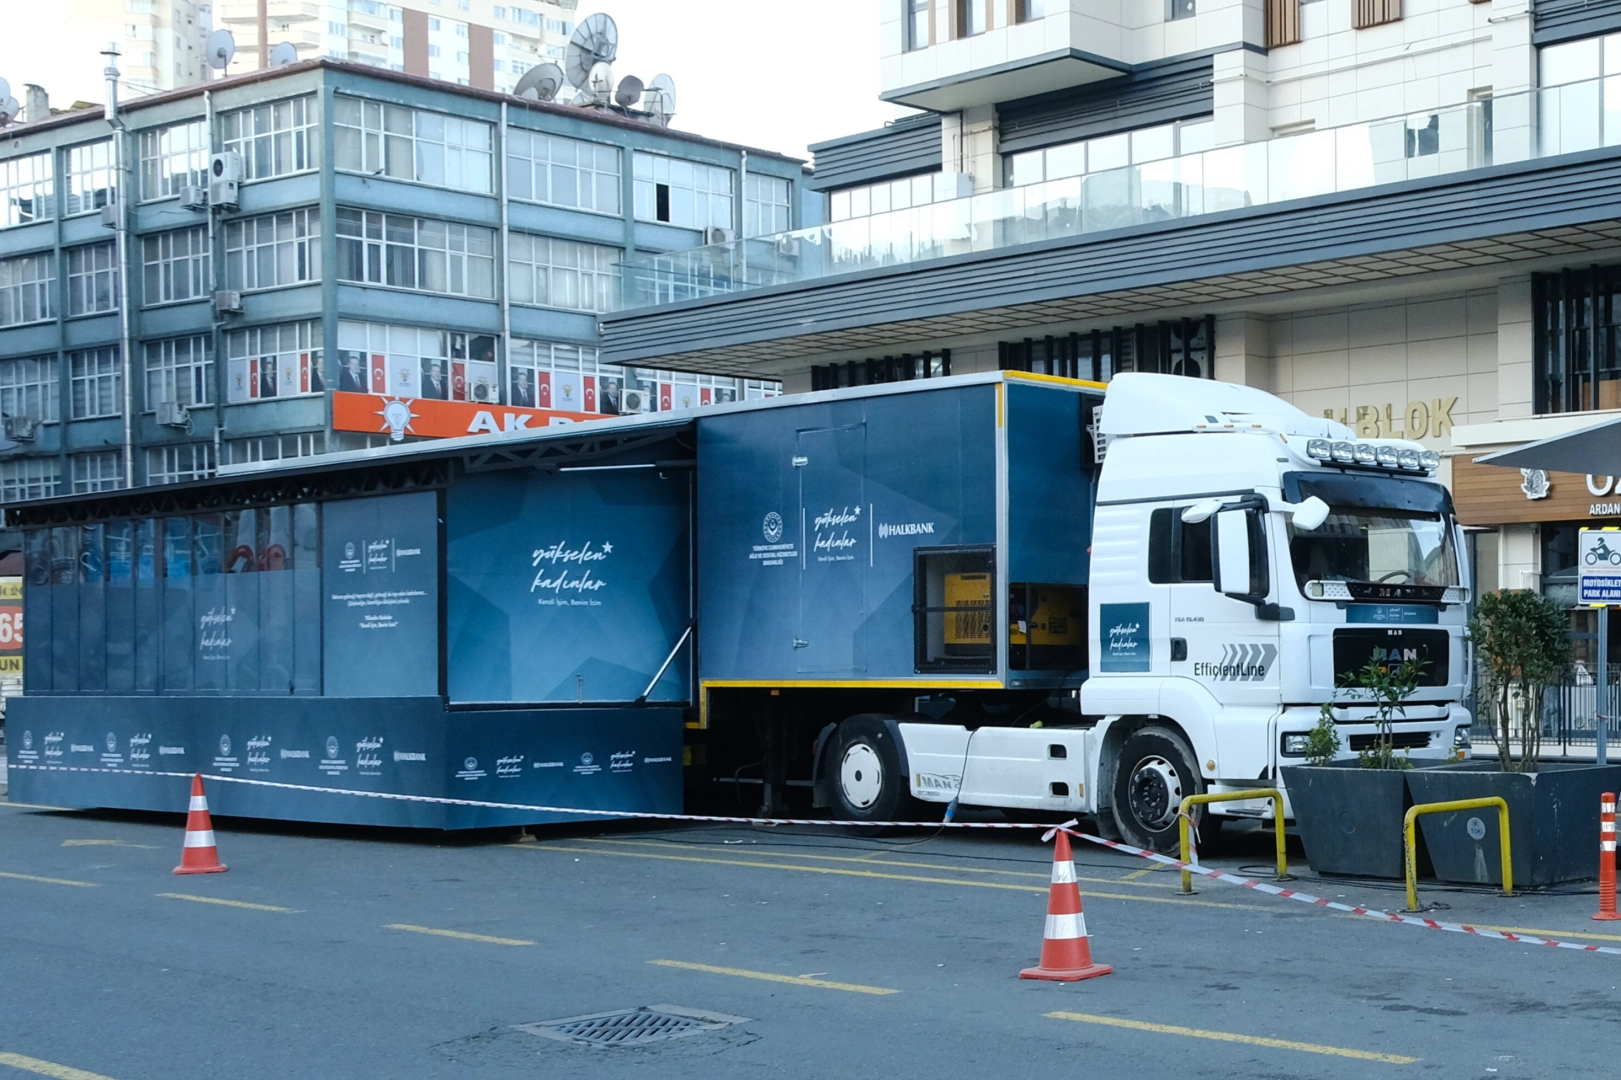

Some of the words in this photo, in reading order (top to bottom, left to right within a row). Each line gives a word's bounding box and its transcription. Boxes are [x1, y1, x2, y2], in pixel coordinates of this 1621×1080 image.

[467, 410, 533, 432] AK
[1356, 397, 1458, 440] BLOK
[888, 522, 935, 536] HALKBANK
[814, 530, 857, 552] kadınlar
[532, 541, 607, 566] yükselen
[530, 568, 607, 593] kadınlar
[1583, 577, 1621, 587] MOTOSİKLET
[1583, 589, 1601, 598] PARK
[1601, 589, 1621, 598] ALANI
[1373, 648, 1417, 661] MAN
[1194, 661, 1265, 677] EfficientLine
[921, 775, 952, 789] MAN
